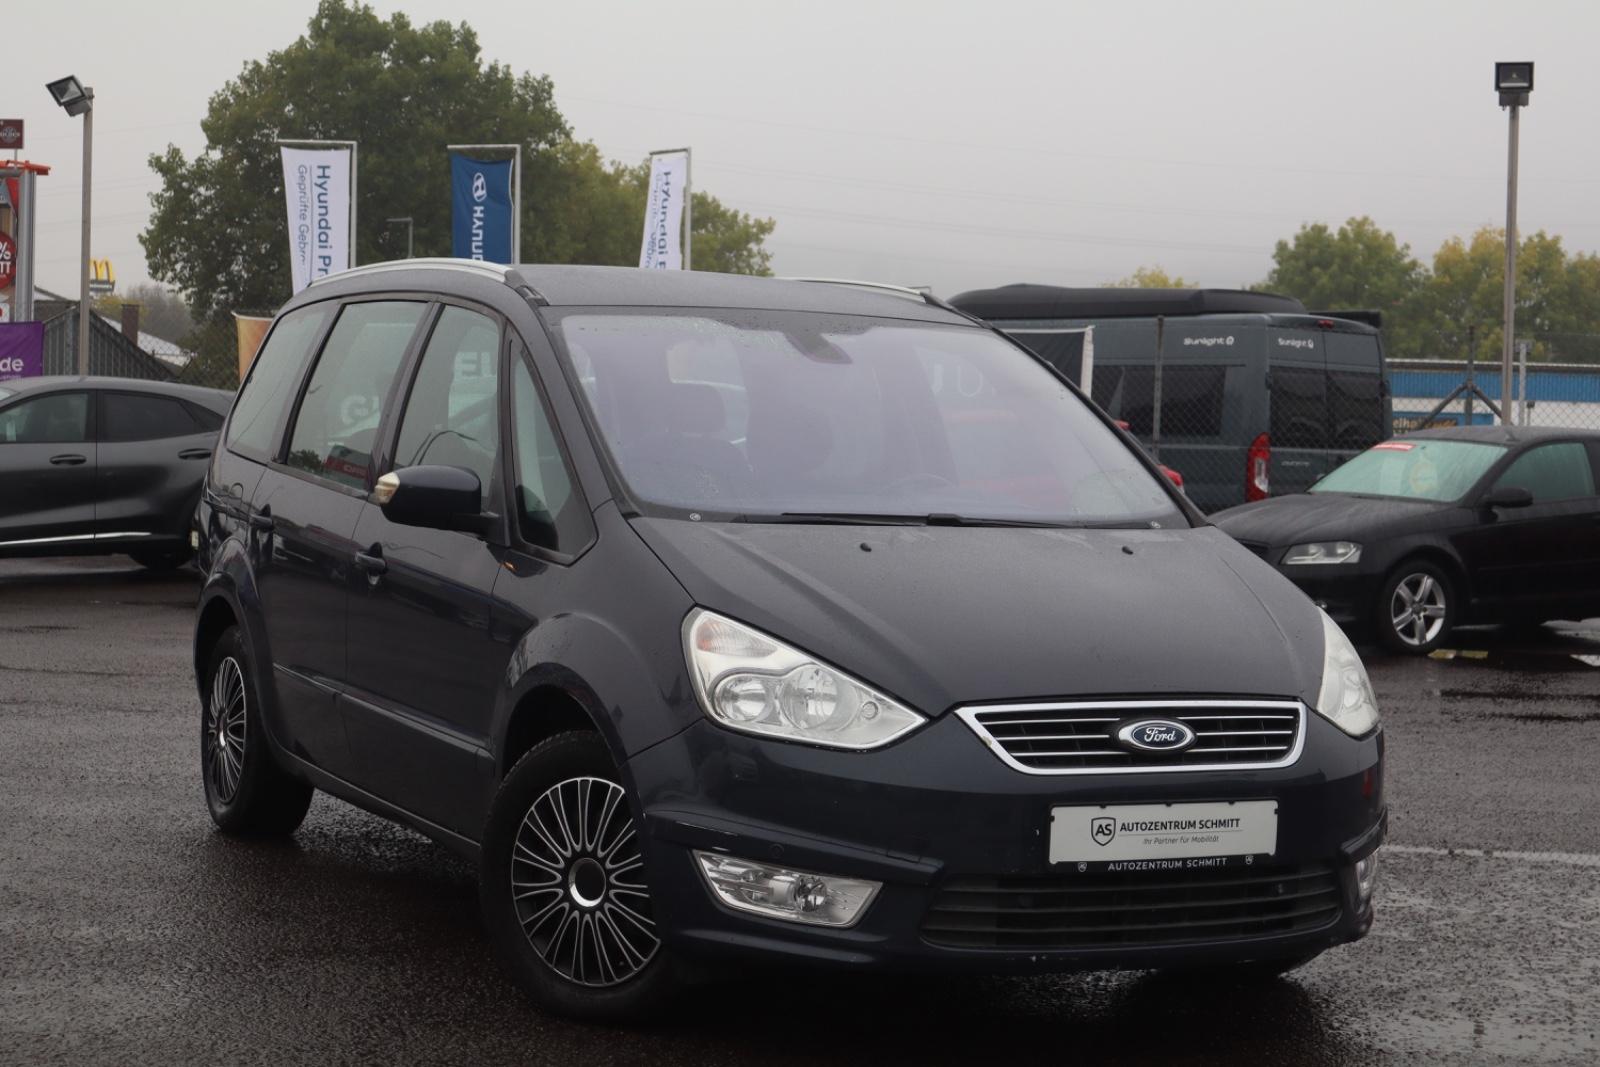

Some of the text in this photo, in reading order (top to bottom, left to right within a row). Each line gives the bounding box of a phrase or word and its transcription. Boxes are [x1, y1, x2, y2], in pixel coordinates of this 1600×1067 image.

[296, 164, 310, 221] Geprüfte
[658, 171, 672, 255] Hyundai
[314, 165, 333, 277] Hyundai Pr
[0, 356, 25, 372] de
[1144, 727, 1177, 742] Ford
[1095, 824, 1113, 837] AS
[1119, 818, 1241, 833] AUTOZENTRUM SCHMITT
[1154, 837, 1178, 845] Partner
[1180, 836, 1189, 844] für
[1191, 835, 1220, 843] Mobilität
[1107, 857, 1228, 872] AUTOZENTRUM SCHMITT
